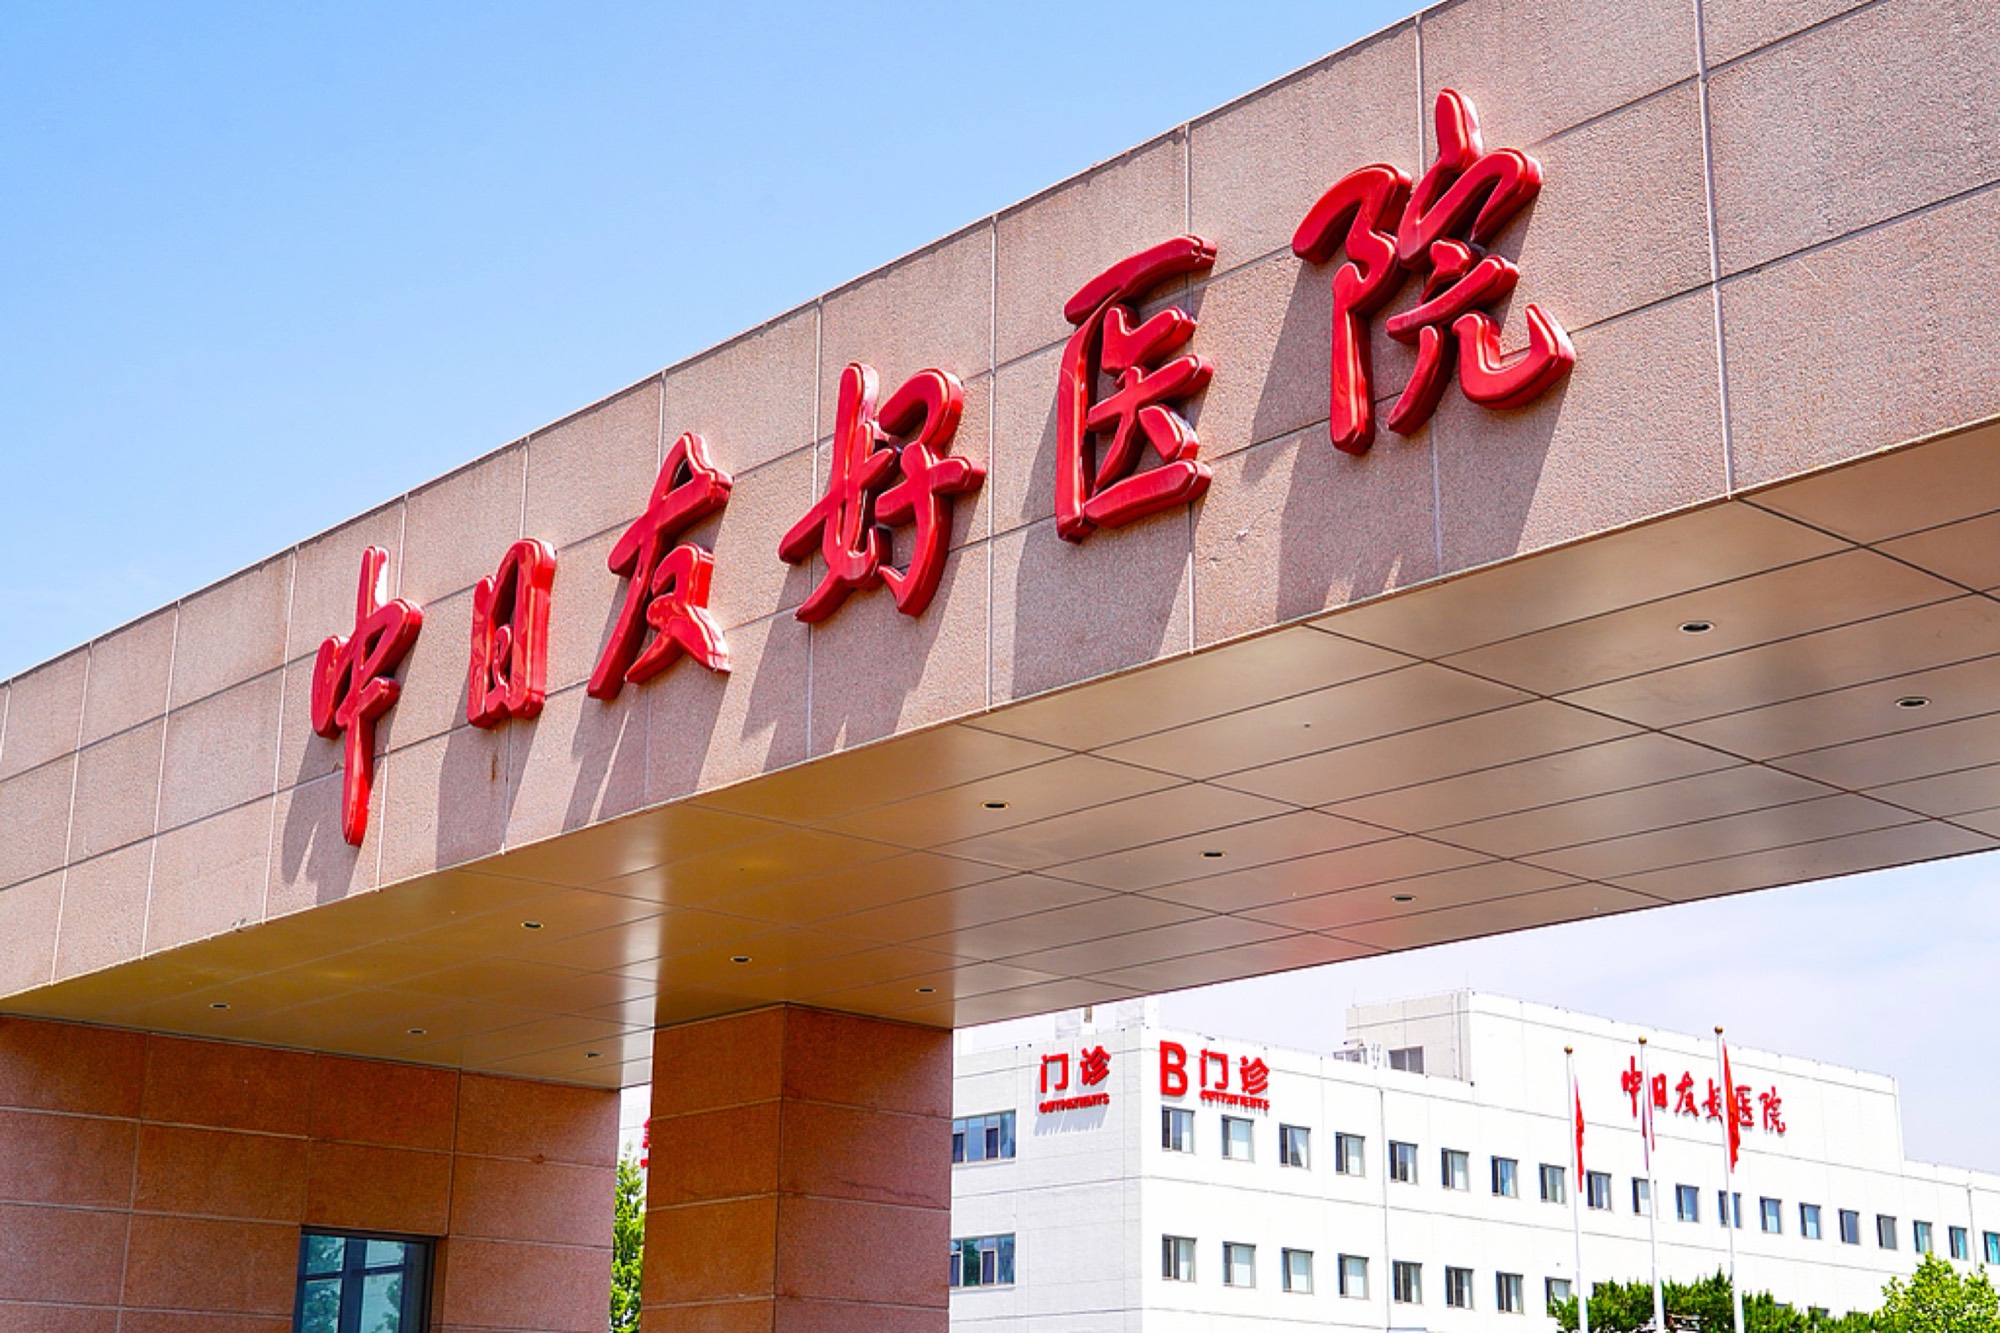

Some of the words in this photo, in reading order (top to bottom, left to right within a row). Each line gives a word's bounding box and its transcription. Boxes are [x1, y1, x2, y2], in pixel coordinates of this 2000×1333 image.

[311, 88, 1576, 847] 中日友好医院
[1040, 1045, 1111, 1094] 门诊
